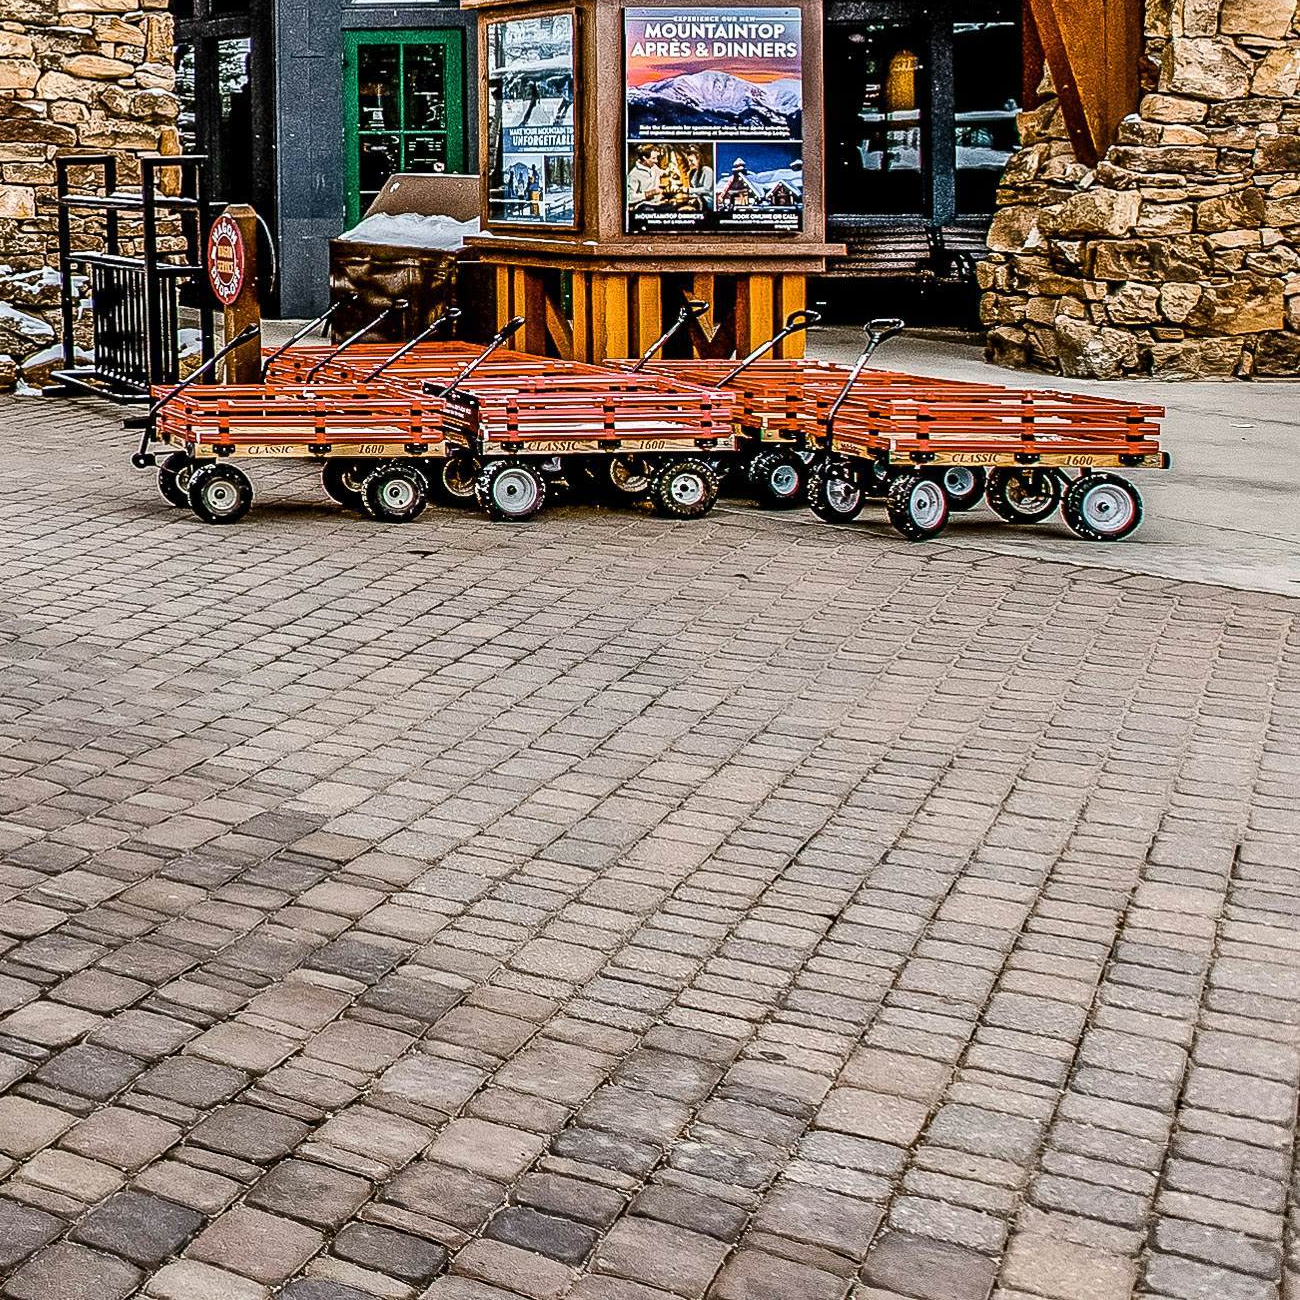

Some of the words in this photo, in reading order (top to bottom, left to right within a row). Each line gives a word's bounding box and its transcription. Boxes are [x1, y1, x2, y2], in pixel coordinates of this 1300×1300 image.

[644, 23, 785, 39] MOUNTAINTOP
[631, 39, 693, 58] APRÈS
[695, 42, 710, 57] &
[713, 42, 798, 58] DINNERS
[513, 134, 574, 146] UNFORGETTABLE
[212, 222, 237, 245] WAGON
[247, 445, 295, 455] CLASSIC
[357, 445, 385, 454] 1600
[526, 441, 582, 451] CLASSIC
[639, 440, 666, 450] 1600
[952, 453, 1002, 463] CLASSIC
[1065, 455, 1094, 466] 1600
